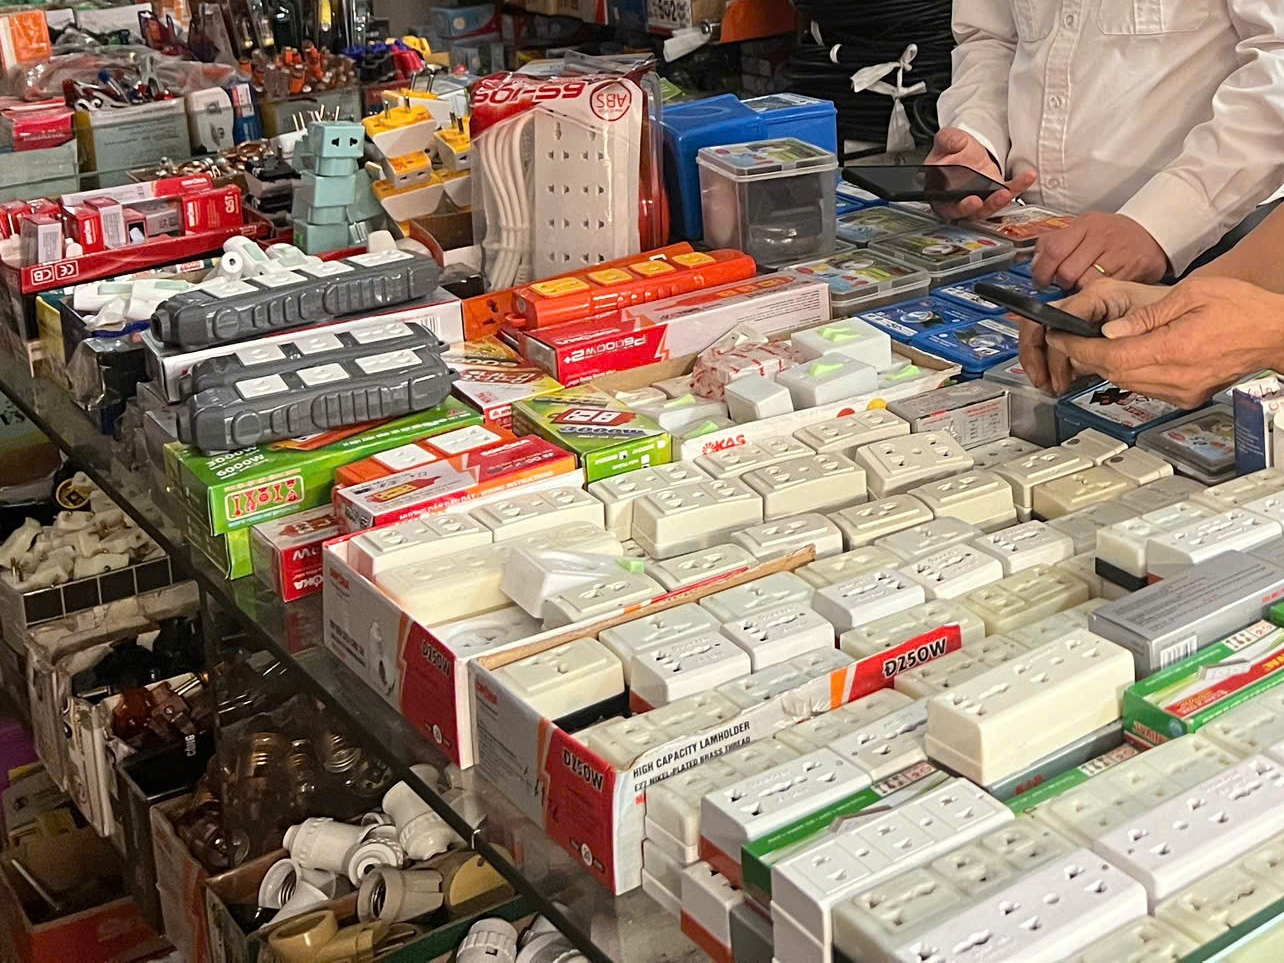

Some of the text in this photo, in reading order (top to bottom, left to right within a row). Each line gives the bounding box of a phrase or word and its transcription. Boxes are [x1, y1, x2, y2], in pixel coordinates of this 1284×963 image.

[596, 93, 627, 109] ABS
[633, 720, 751, 779] HIGH CAPACITY LAMHOLDER
